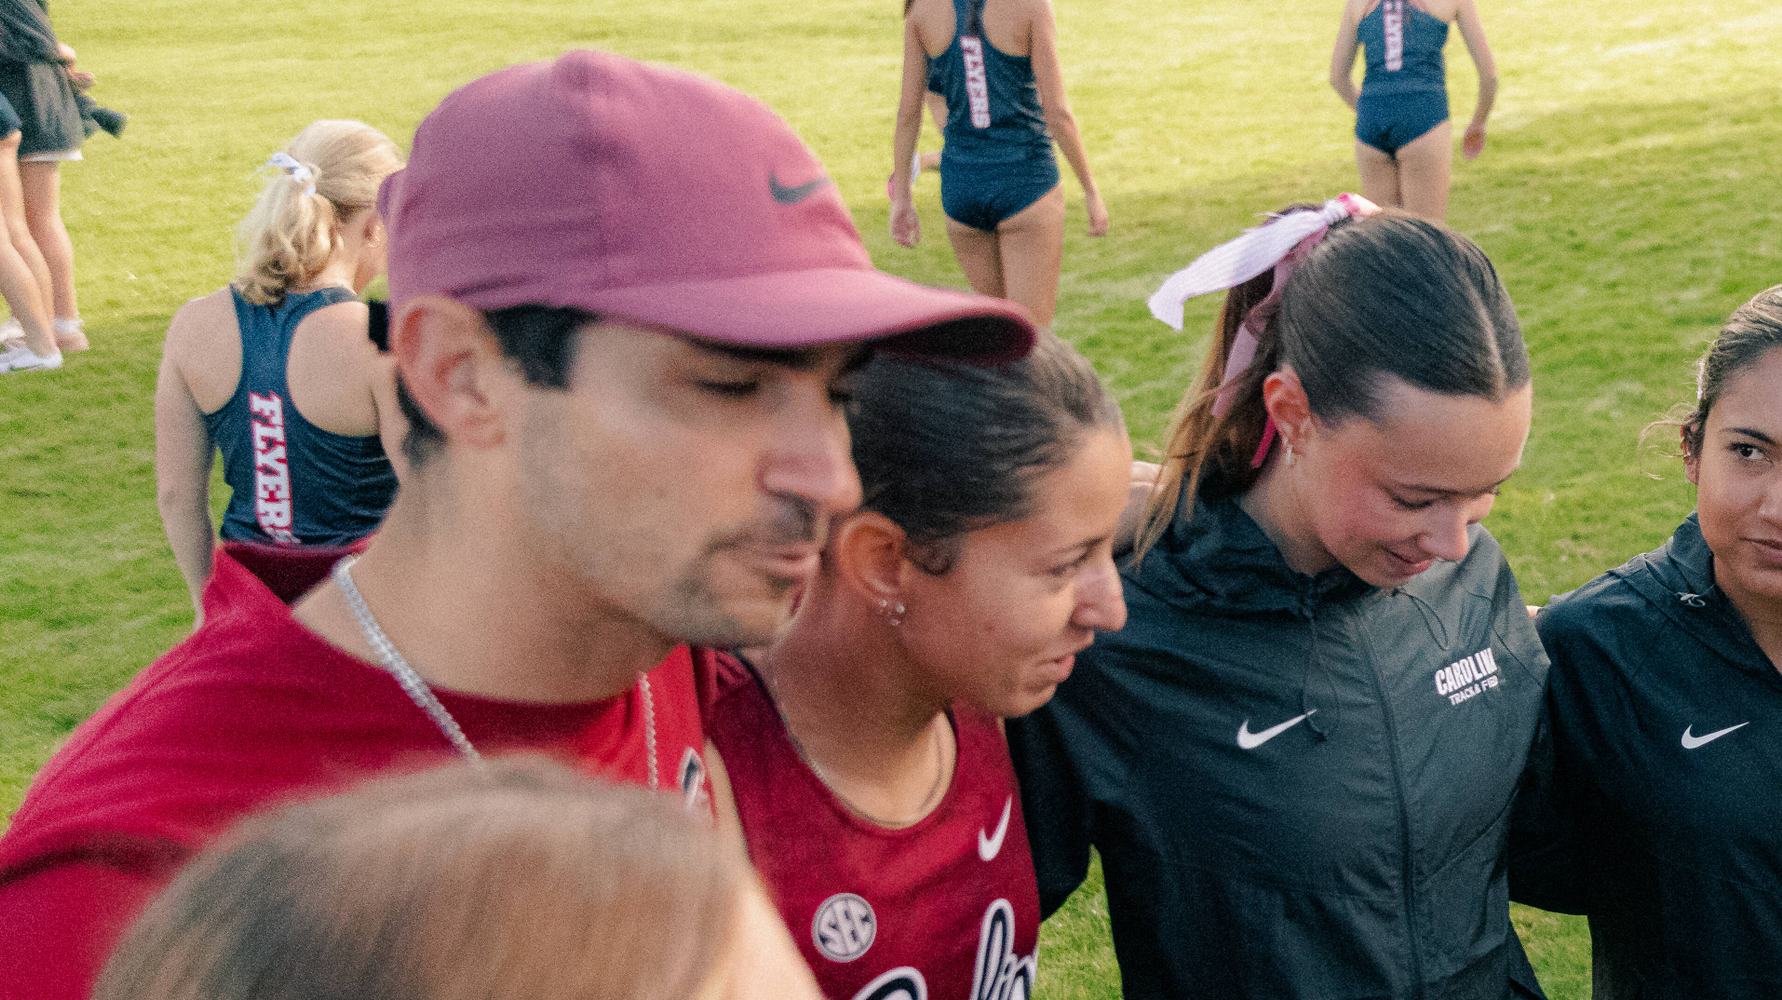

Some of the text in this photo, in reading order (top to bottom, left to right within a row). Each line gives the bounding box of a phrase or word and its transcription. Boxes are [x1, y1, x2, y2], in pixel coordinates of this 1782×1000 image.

[960, 35, 991, 129] FLYERS
[1434, 647, 1498, 696] CAROLIN
[1448, 686, 1475, 706] TRACK
[817, 898, 873, 959] SEC
